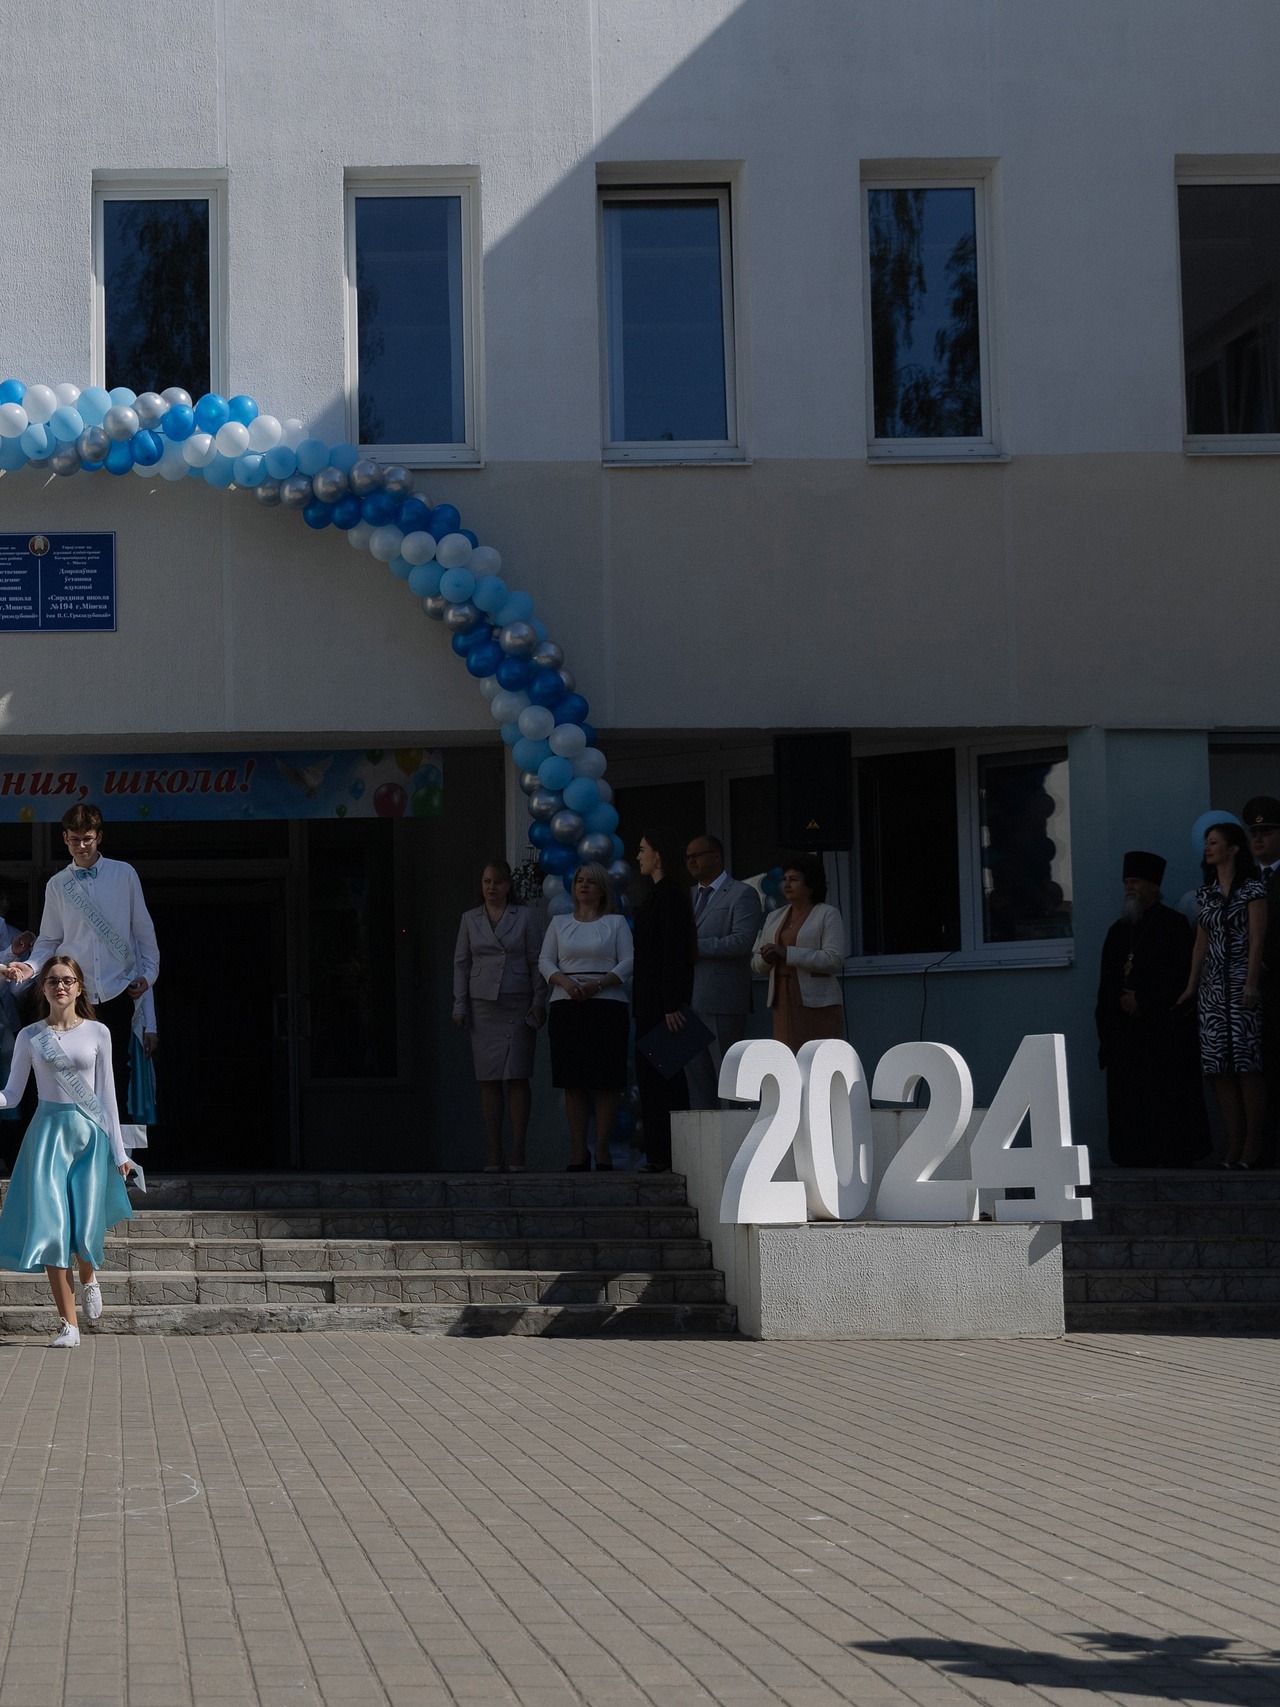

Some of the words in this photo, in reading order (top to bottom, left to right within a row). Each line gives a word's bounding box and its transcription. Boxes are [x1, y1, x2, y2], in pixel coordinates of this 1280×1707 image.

[104, 759, 257, 795] школа!
[63, 878, 111, 938] Выпускник
[717, 1032, 1094, 1225] 2024
